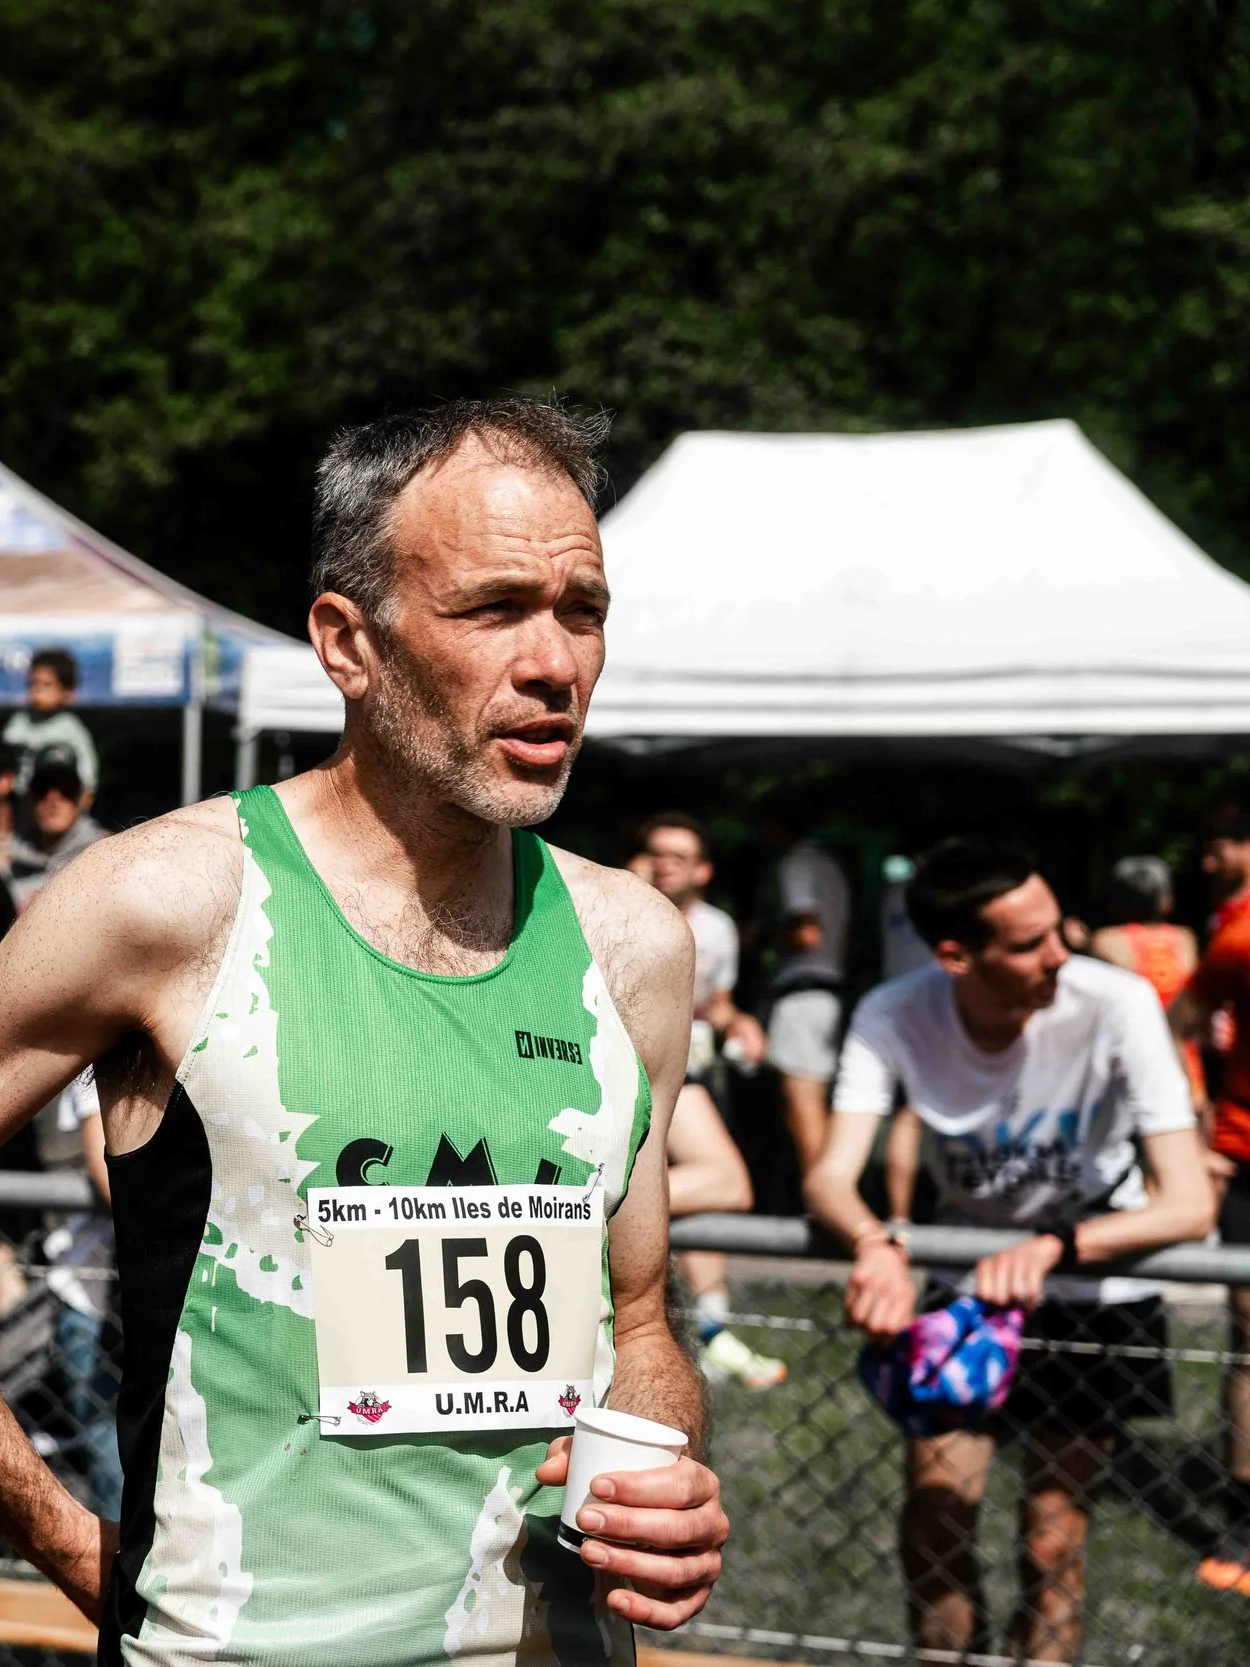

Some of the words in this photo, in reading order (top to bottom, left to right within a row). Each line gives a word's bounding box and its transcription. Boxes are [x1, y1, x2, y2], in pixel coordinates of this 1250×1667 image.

[318, 1199, 367, 1223] 5km
[388, 1197, 446, 1220] 10km
[451, 1196, 491, 1219] Iles
[498, 1196, 522, 1219] de
[528, 1195, 591, 1220] Moirans
[385, 1234, 550, 1374] 158
[356, 1407, 384, 1415] UMRA
[435, 1391, 529, 1415] U.M.R.A
